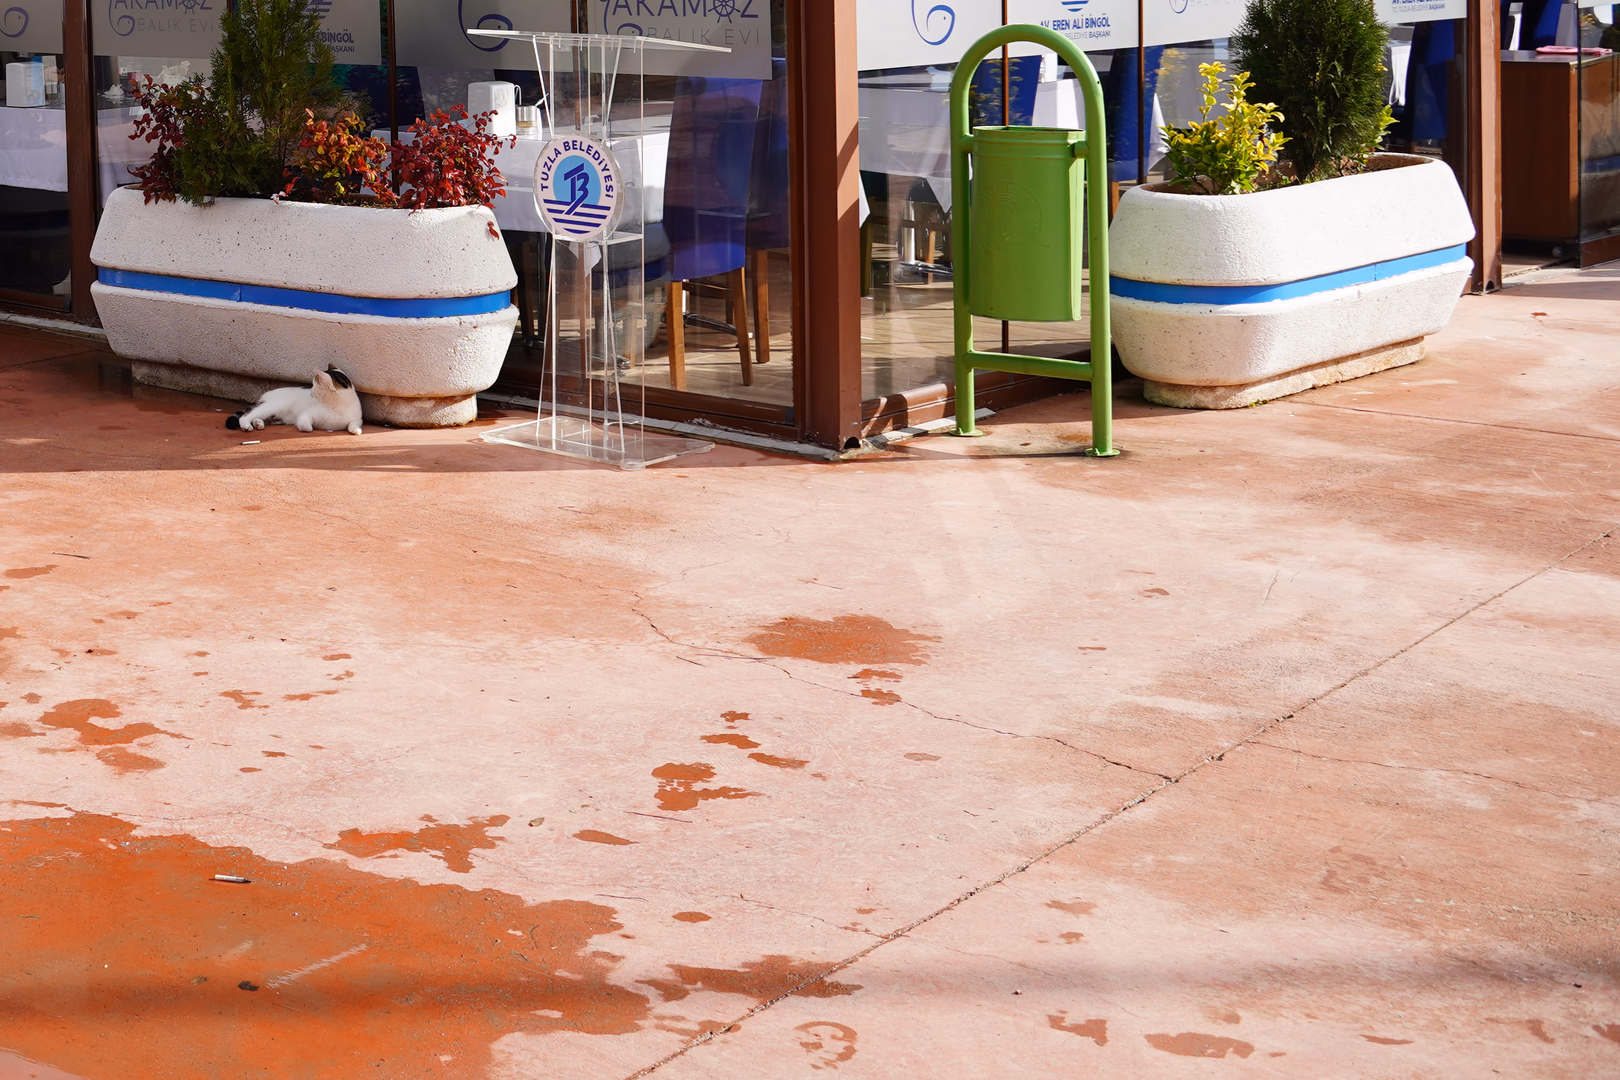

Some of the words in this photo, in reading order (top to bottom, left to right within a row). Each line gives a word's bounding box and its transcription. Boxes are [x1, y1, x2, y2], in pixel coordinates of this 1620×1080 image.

[1428, 3, 1445, 11] BAŞKANI
[137, 17, 182, 32] BALIK
[1040, 20, 1050, 28] AV
[1052, 19, 1070, 31] EREN
[1072, 14, 1084, 30] ALİ
[1085, 13, 1111, 29] BİNGÖL
[320, 28, 354, 43] BİNGÖL
[724, 27, 760, 45] EVİ
[1088, 30, 1111, 39] BAŞKANI
[540, 147, 562, 192] TUZLA
